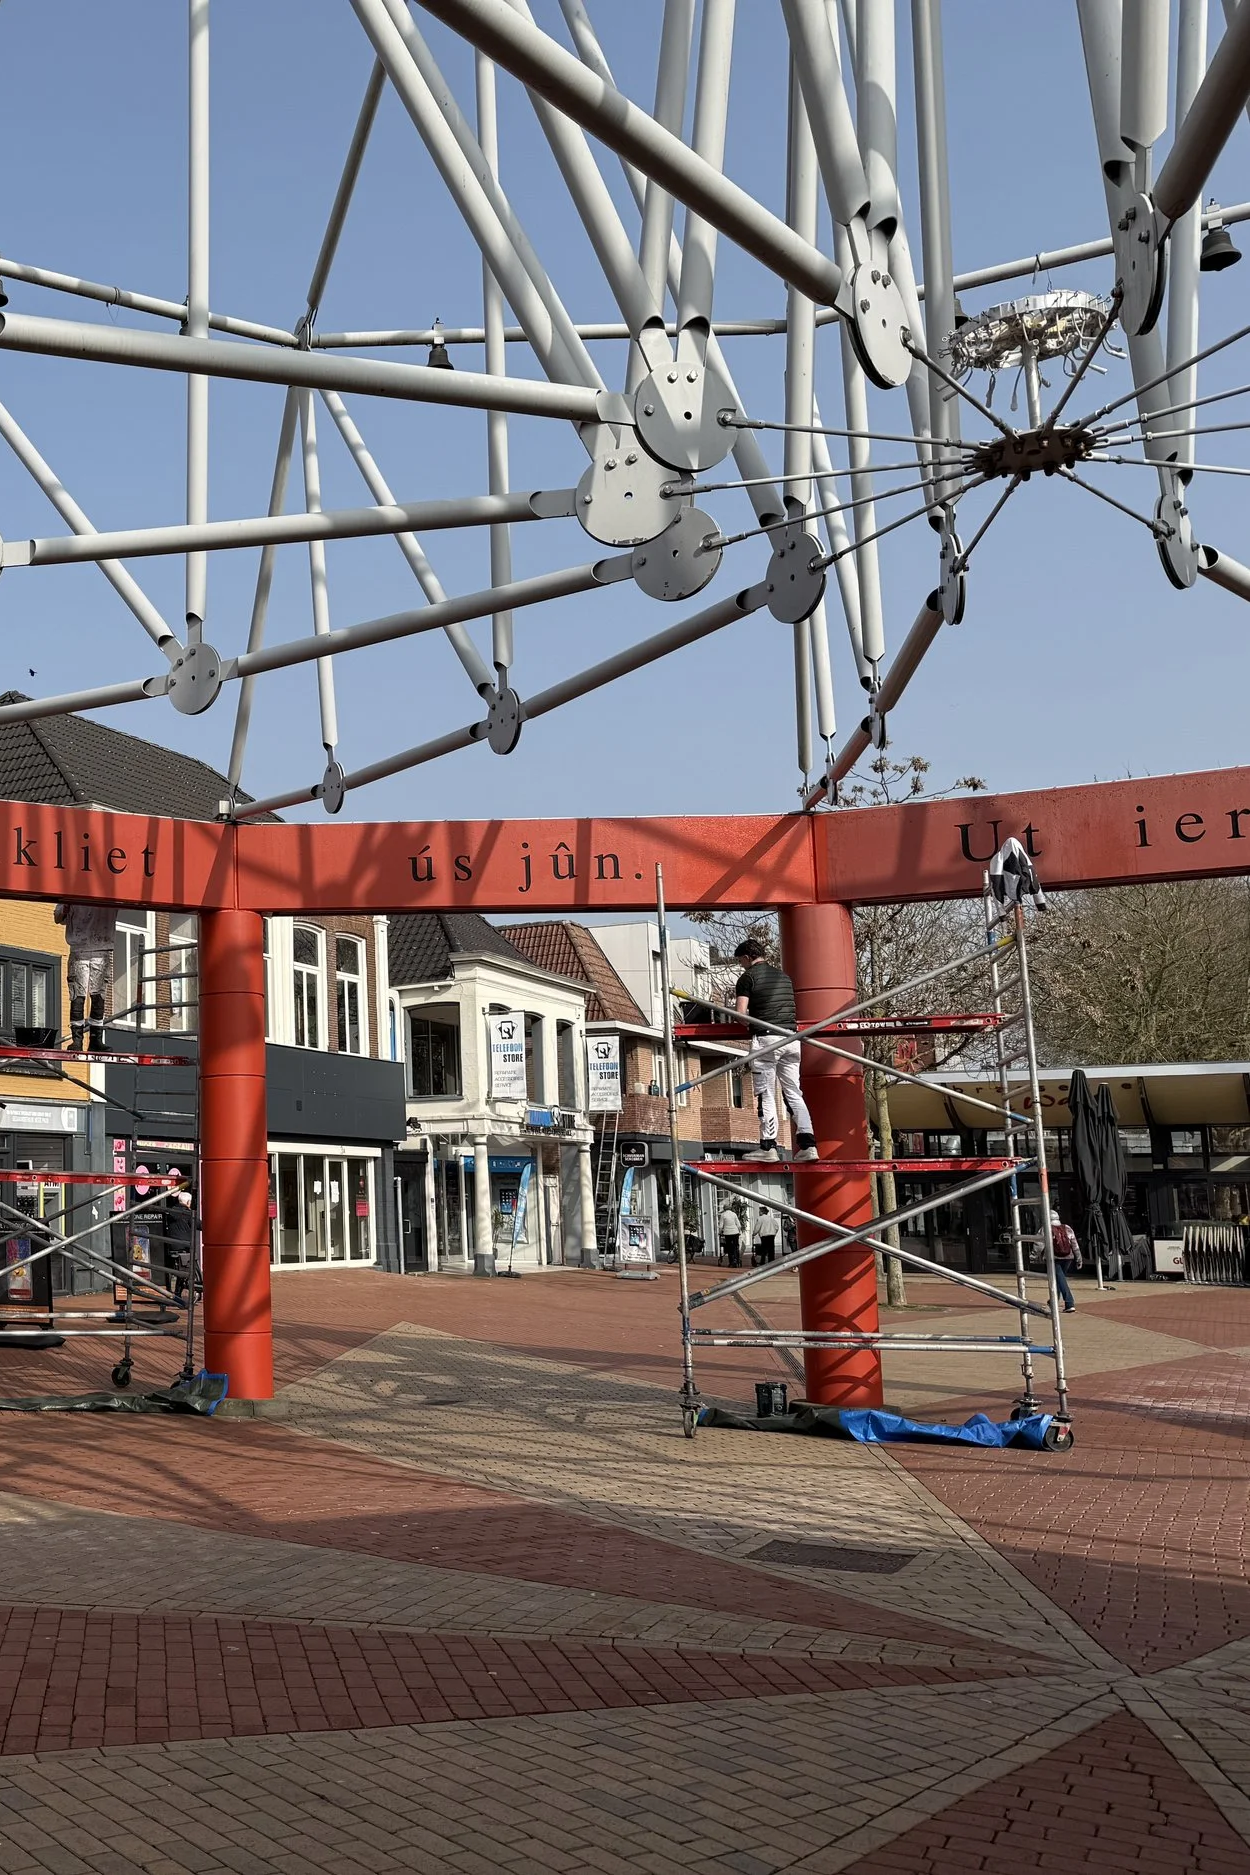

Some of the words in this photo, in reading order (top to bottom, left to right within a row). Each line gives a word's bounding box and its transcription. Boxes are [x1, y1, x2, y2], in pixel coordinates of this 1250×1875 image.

[407, 844, 473, 882] ús
[518, 841, 643, 893] jûn.
[492, 1043, 523, 1053] TELEFOON
[502, 1053, 524, 1063] STORE
[589, 1062, 619, 1071] TELEFOON
[599, 1071, 619, 1080] STORE
